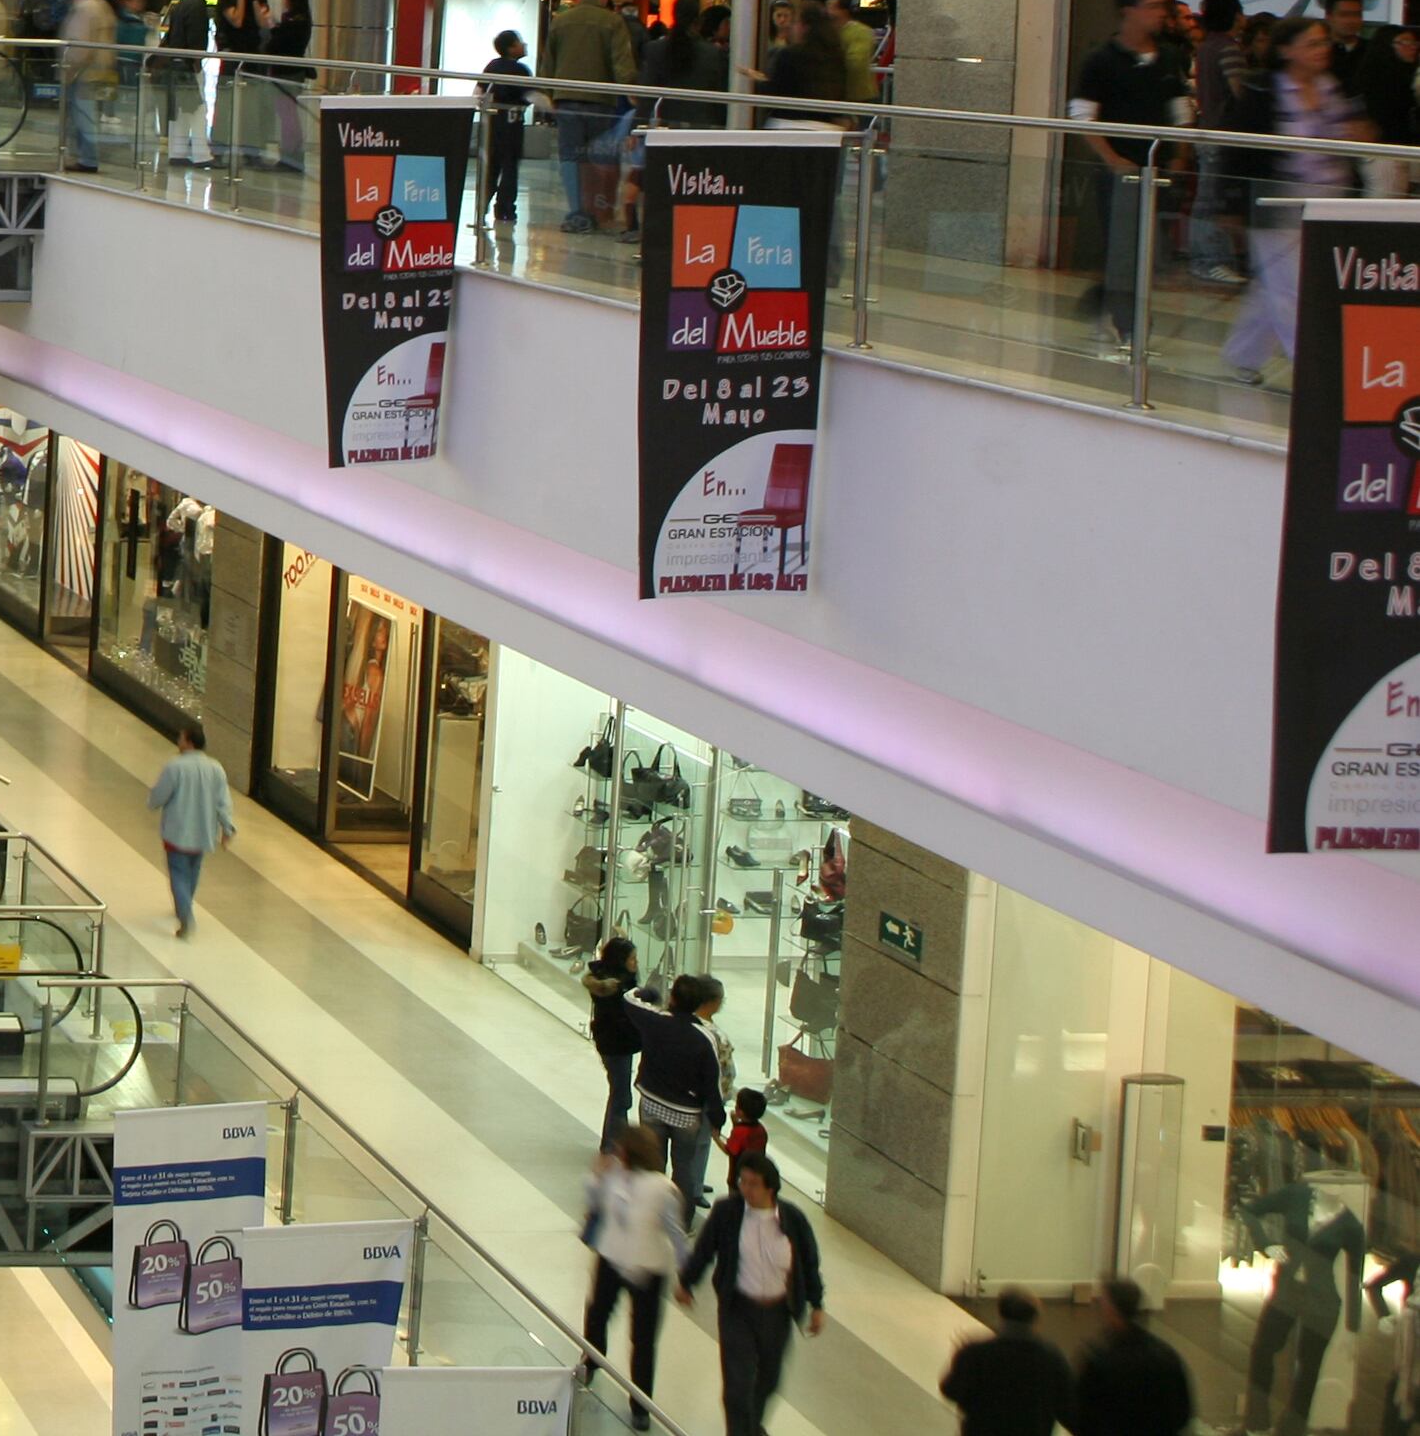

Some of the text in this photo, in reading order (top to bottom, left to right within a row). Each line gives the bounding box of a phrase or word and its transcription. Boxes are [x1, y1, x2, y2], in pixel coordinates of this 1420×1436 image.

[356, 178, 440, 203] La Feria
[348, 240, 453, 268] del Mueble
[685, 234, 792, 265] La Feria
[342, 292, 377, 310] Del
[384, 292, 396, 308] 8
[402, 290, 420, 308] al
[374, 311, 424, 331] Mayo
[672, 313, 807, 349] del Mueble
[1362, 346, 1404, 389] La
[663, 375, 809, 400] Del 8 al 23
[352, 411, 381, 421] GRAN
[702, 402, 765, 428] Mayo
[348, 447, 399, 463] PLAZOLETA
[703, 470, 746, 496] En...
[1343, 463, 1393, 503] del
[668, 526, 773, 540] GRAN ESTACION
[1329, 552, 1394, 580] Del
[660, 574, 726, 593] PLAZOLETA
[728, 573, 745, 591] DE
[748, 573, 773, 591] LOS
[1331, 762, 1389, 776] GRAN
[223, 1126, 256, 1140] BBVA
[363, 1245, 401, 1260] BBVA
[517, 1400, 558, 1414] BBVA
